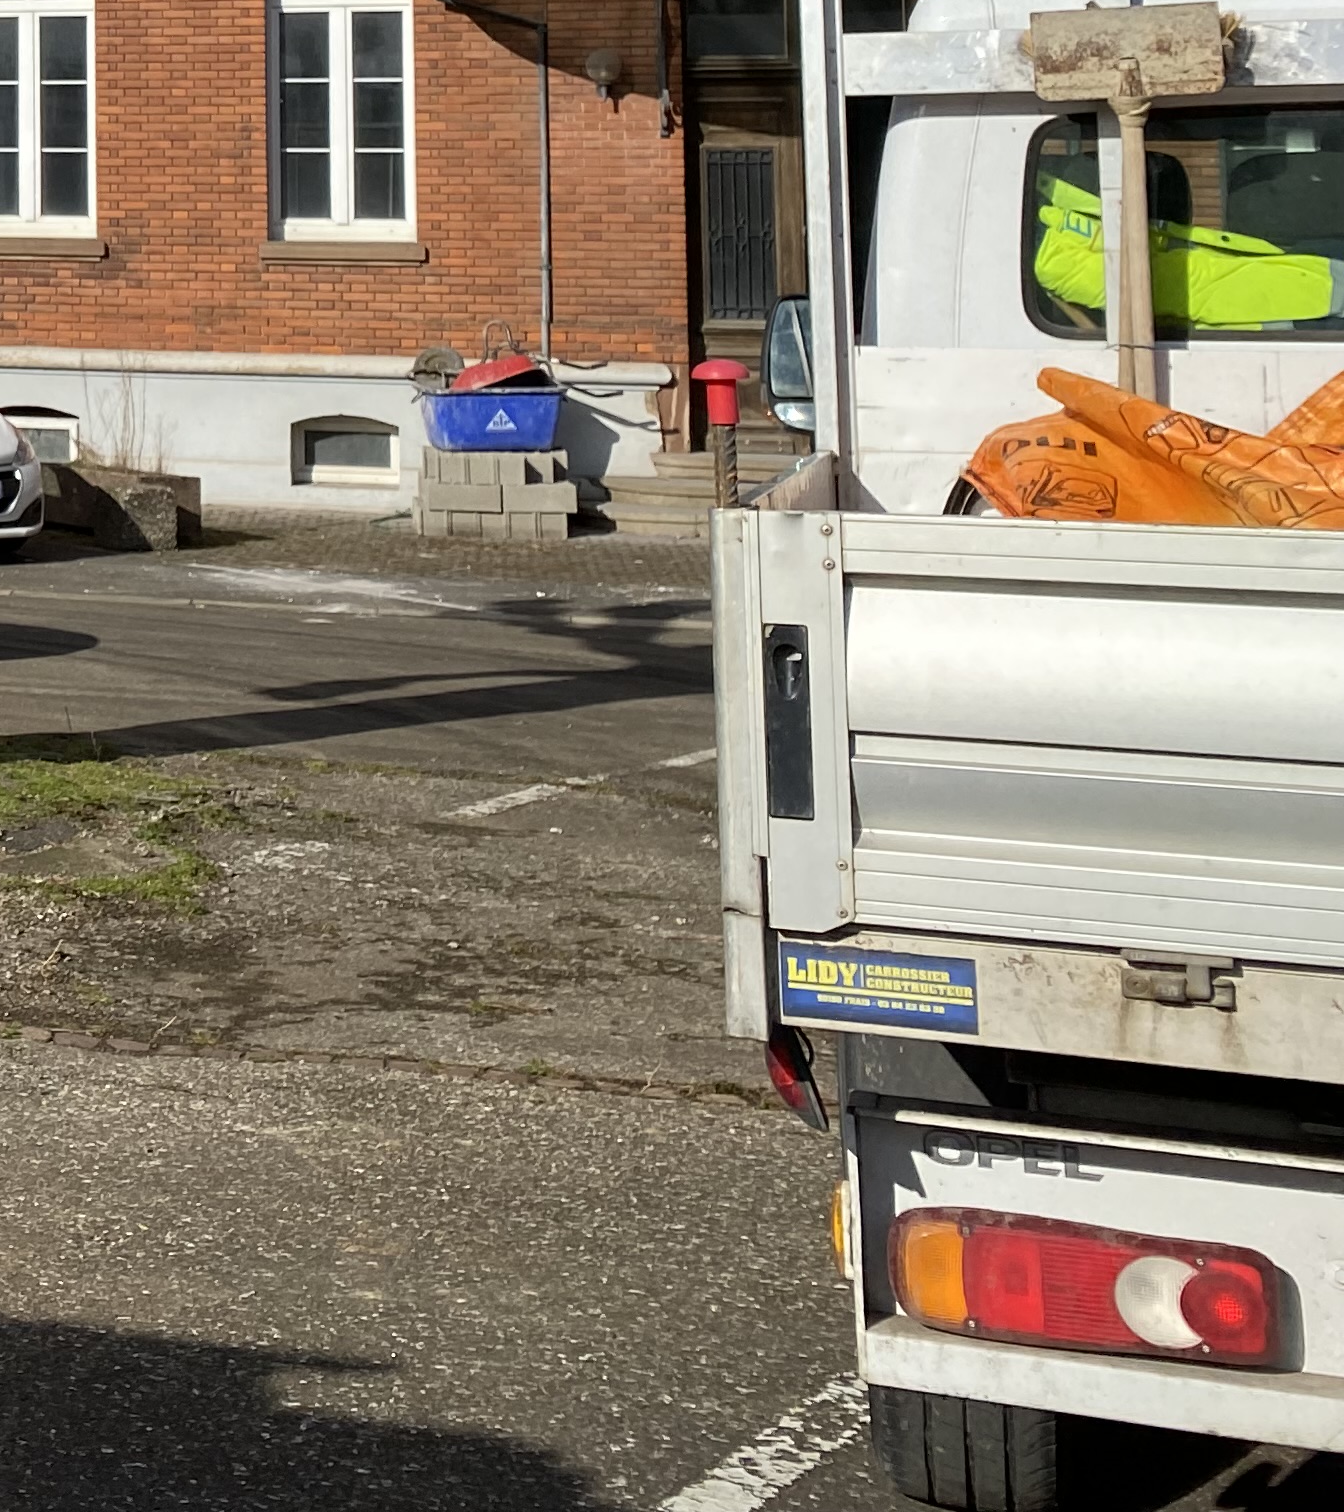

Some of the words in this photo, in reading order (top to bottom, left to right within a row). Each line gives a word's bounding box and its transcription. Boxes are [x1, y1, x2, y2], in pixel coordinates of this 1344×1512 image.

[787, 956, 858, 987] LIDY
[865, 964, 951, 984] CARROSSIER
[865, 977, 973, 998] CONSTRUCTEUR
[923, 1128, 1105, 1183] OPEL
